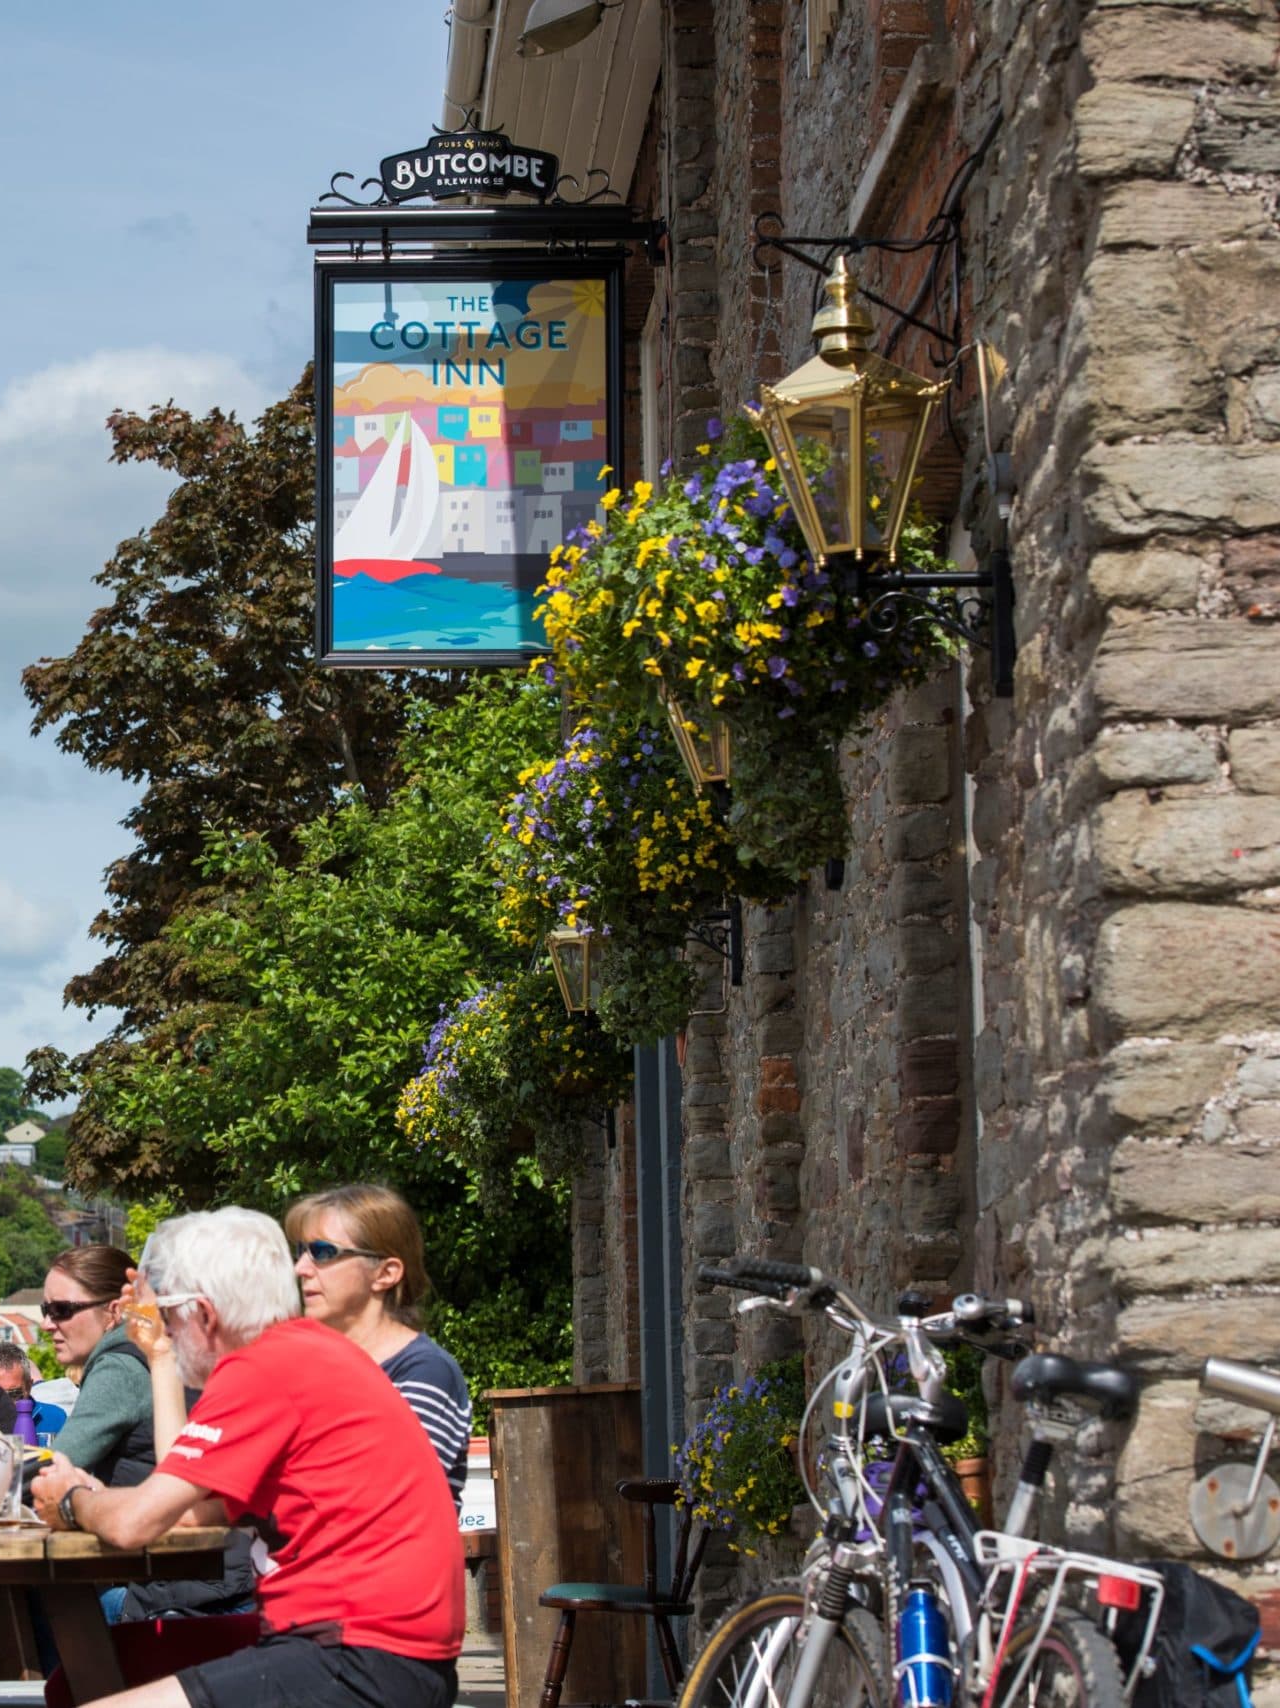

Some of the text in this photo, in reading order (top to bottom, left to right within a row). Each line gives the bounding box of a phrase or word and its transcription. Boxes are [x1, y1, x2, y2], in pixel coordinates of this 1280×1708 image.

[464, 138, 475, 150] &
[391, 152, 545, 190] BUTCOMBE
[437, 177, 490, 187] BREWING
[447, 296, 489, 312] THE
[370, 321, 568, 350] COTTAGE
[432, 358, 506, 386] INN
